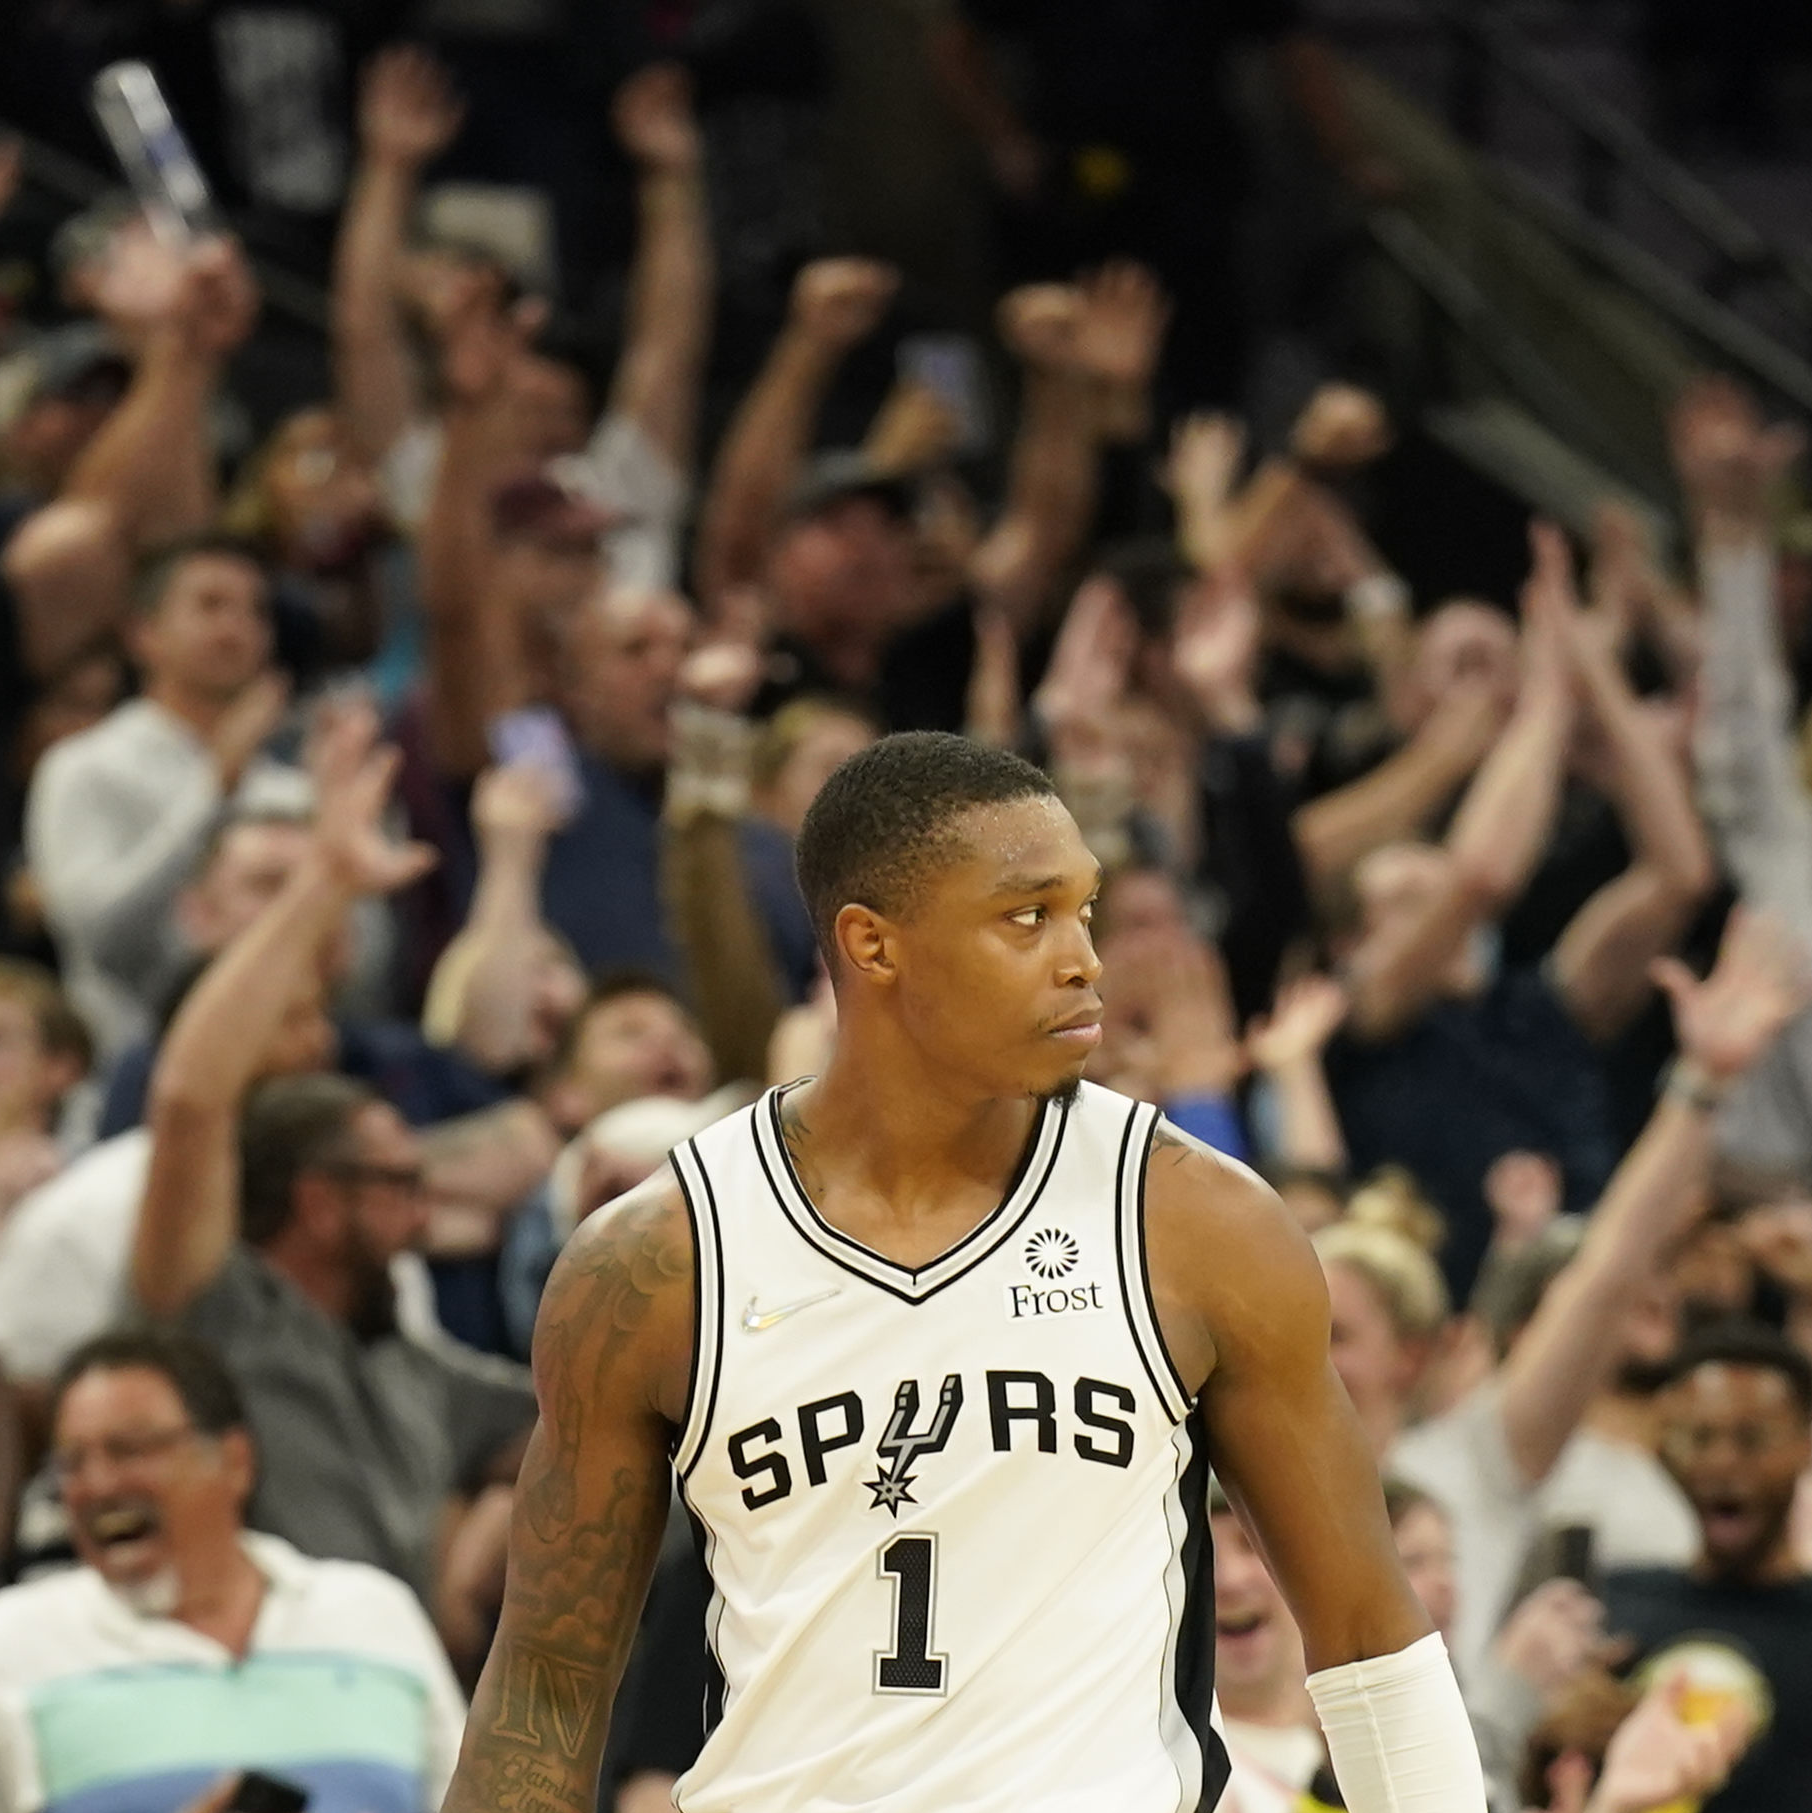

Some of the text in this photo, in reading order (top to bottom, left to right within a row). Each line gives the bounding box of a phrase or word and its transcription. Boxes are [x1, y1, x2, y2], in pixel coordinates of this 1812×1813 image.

[1008, 1281, 1104, 1318] Frost
[727, 1370, 1137, 1519] SPURS
[872, 1532, 949, 1697] 1
